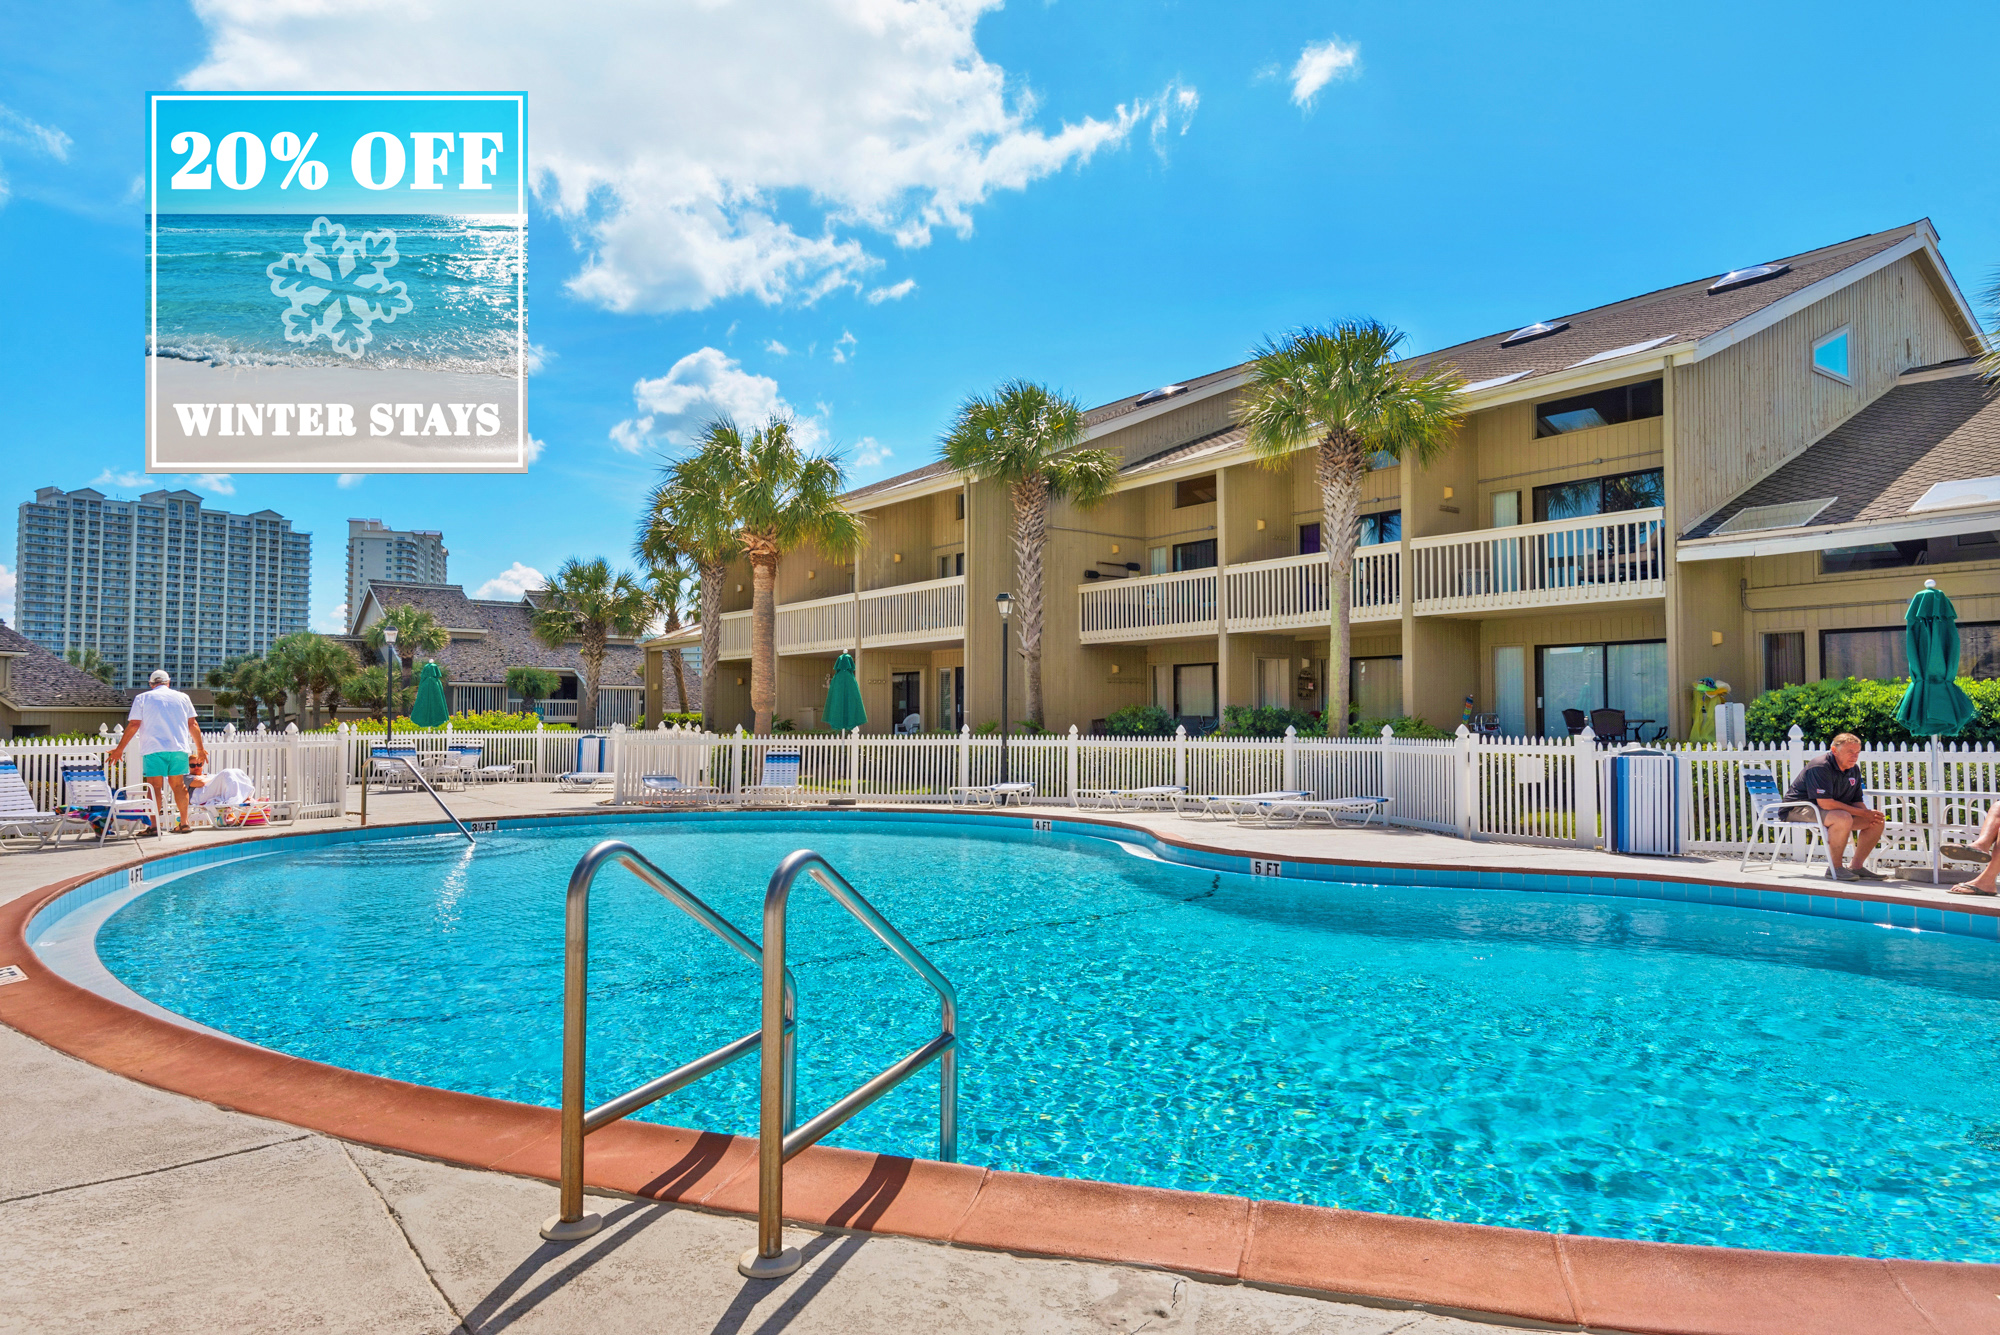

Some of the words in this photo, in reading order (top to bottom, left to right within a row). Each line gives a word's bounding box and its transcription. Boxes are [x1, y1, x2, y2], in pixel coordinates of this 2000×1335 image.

[1035, 820, 1040, 831] 4
[1255, 861, 1262, 875] 5
[130, 869, 134, 884] 4
